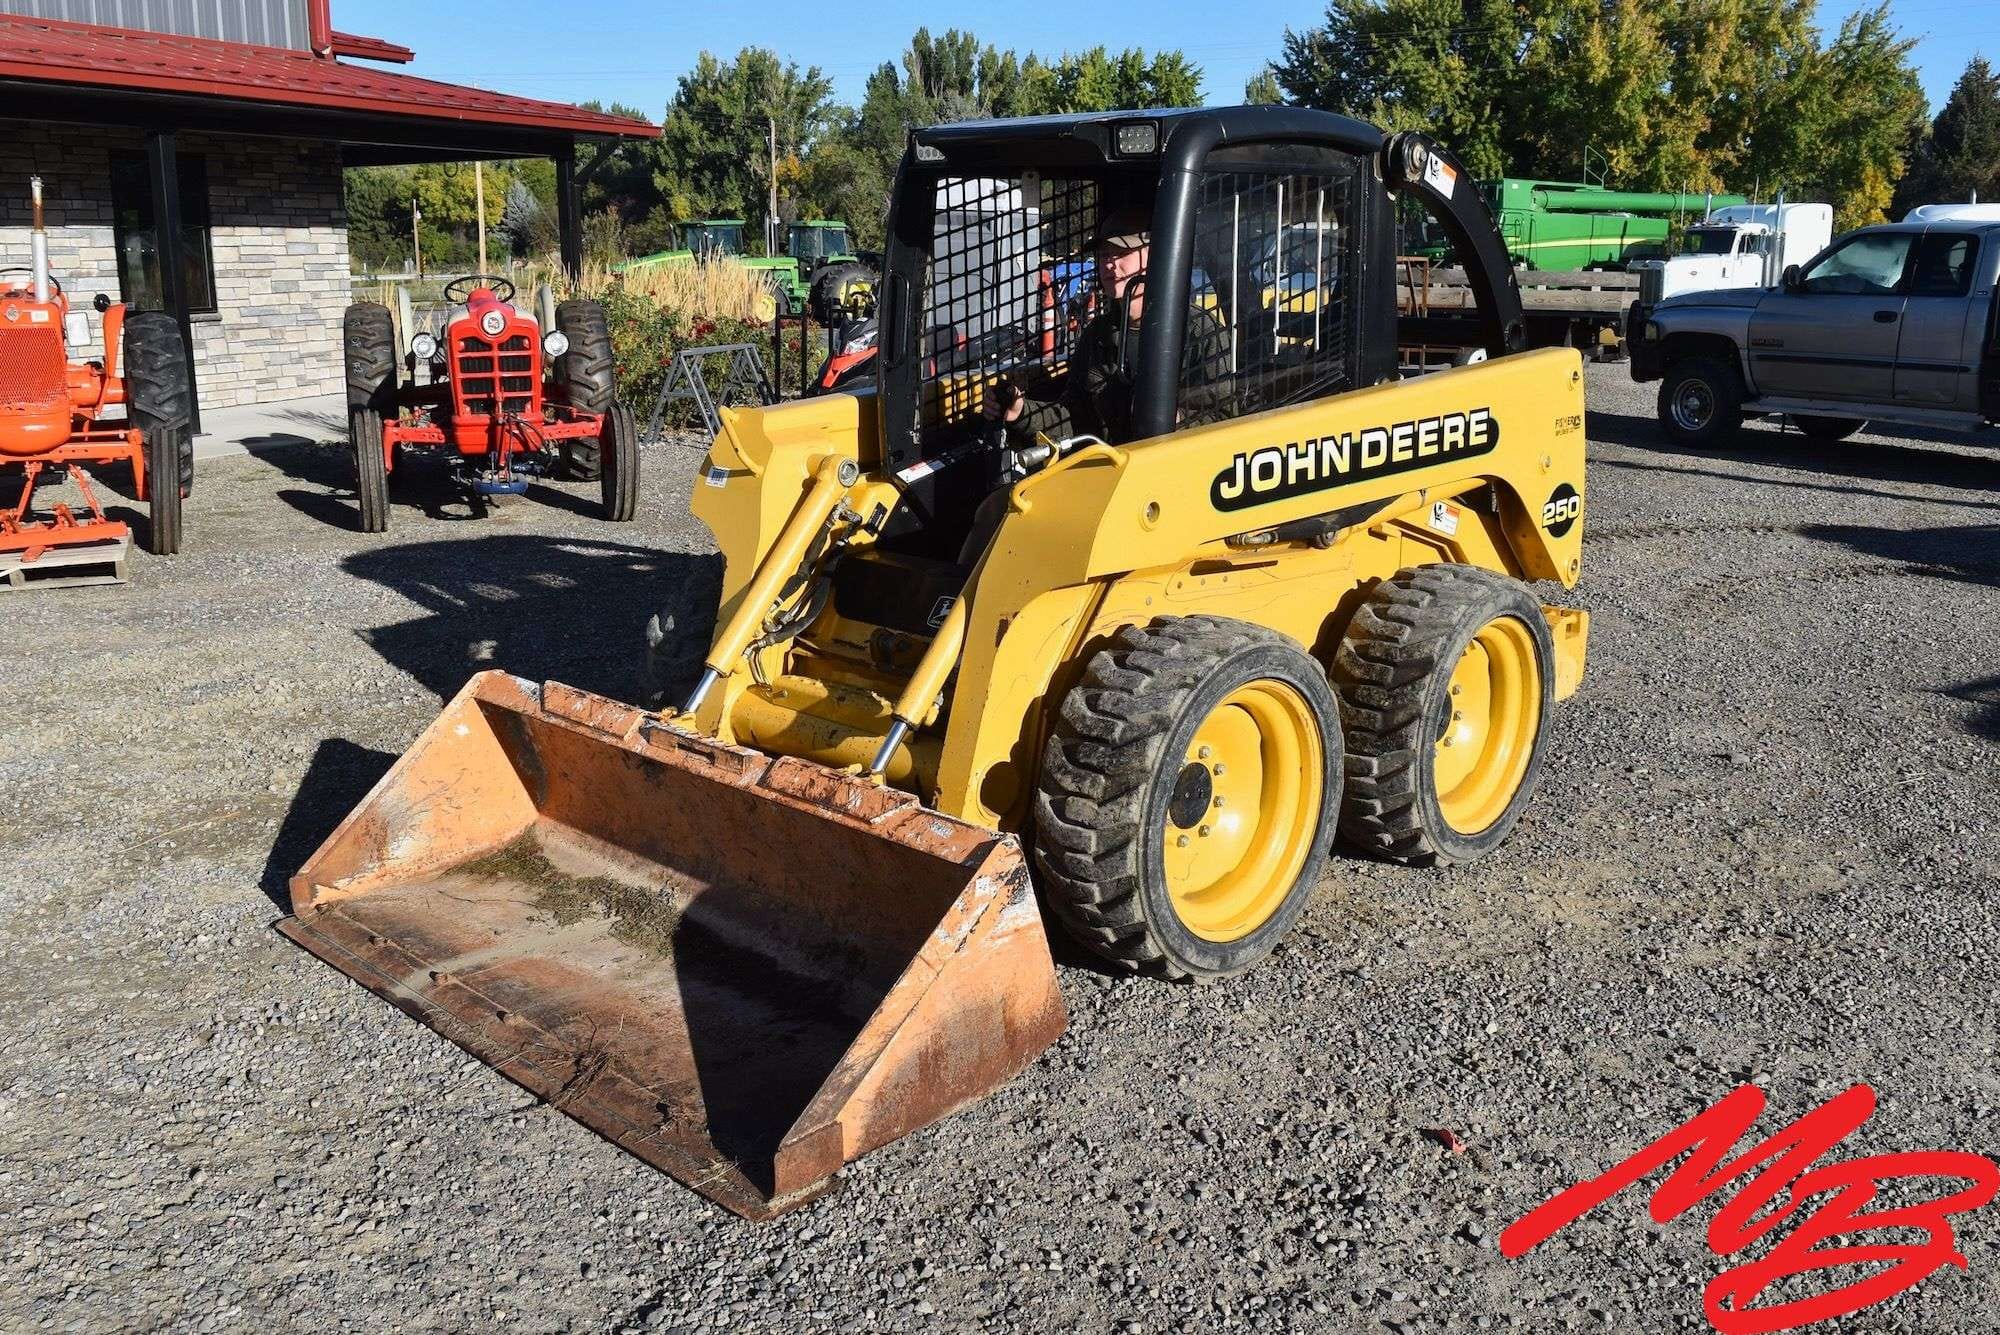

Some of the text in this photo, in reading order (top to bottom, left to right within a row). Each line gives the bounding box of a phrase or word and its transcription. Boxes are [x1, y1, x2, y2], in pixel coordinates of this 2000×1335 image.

[1219, 408, 1490, 500] JOHN DEERE
[1542, 495, 1581, 528] 250
